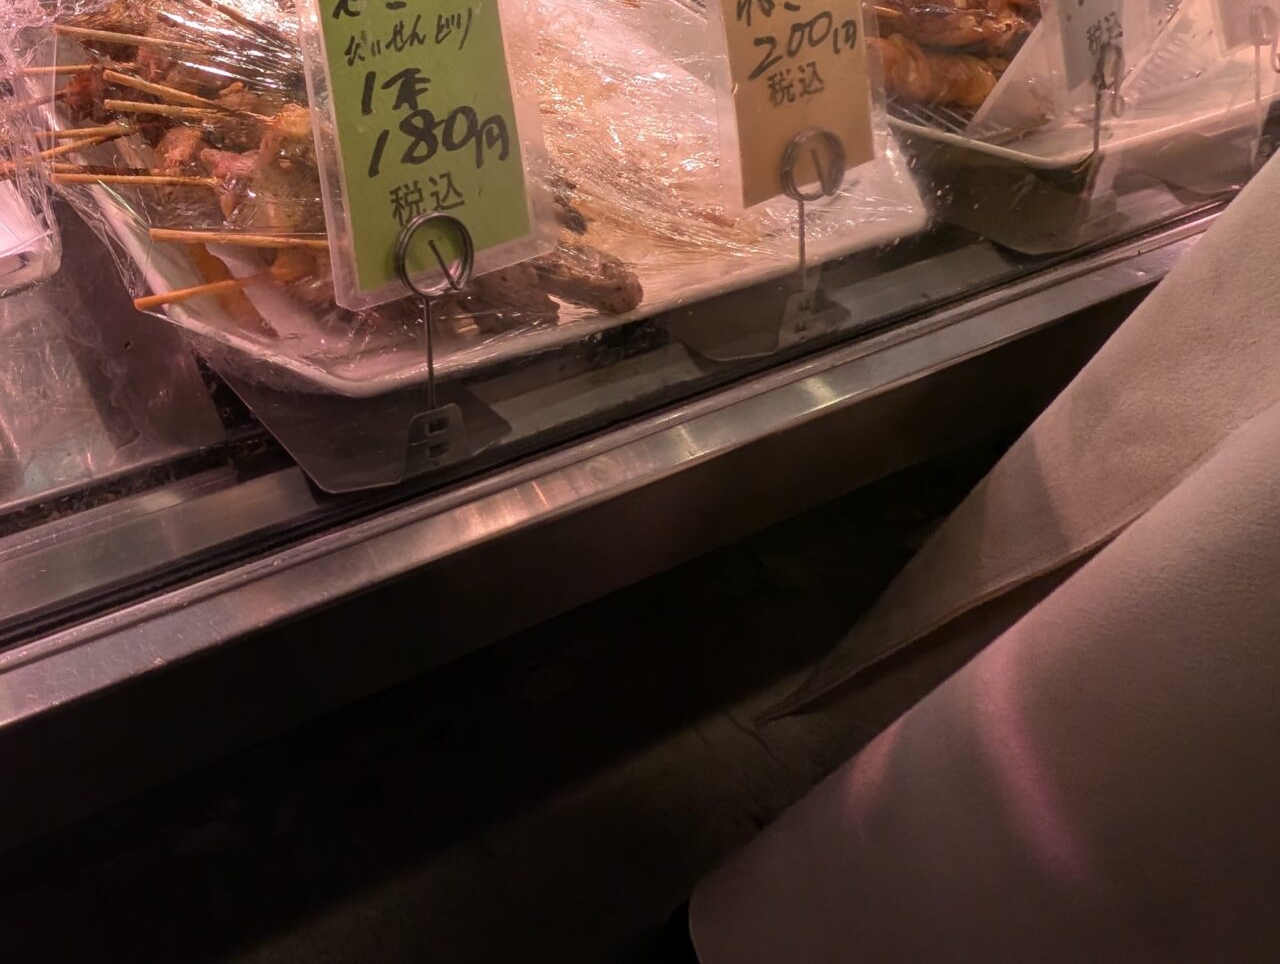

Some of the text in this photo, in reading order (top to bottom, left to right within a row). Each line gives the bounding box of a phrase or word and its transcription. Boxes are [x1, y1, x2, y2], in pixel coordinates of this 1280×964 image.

[747, 11, 858, 81] 200円
[361, 67, 432, 116] 1本
[767, 61, 825, 108] 税込
[368, 105, 510, 179] 180円
[389, 172, 466, 227] 税込
